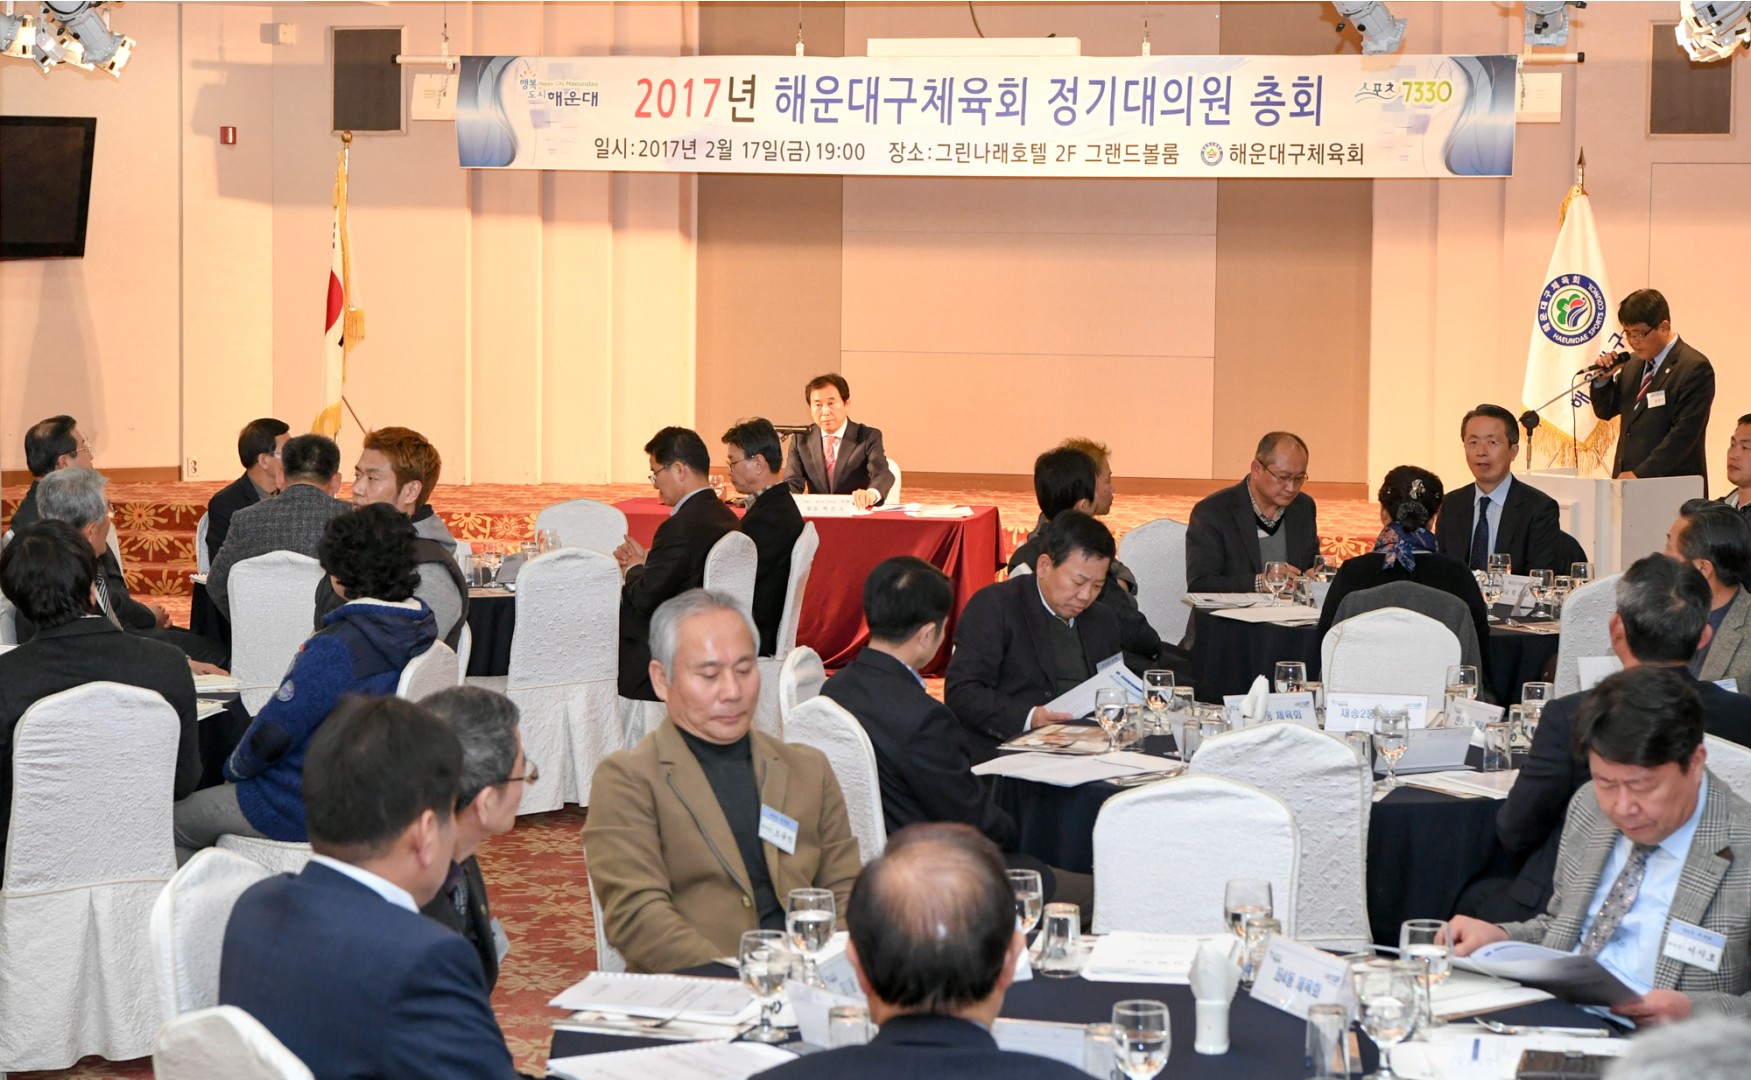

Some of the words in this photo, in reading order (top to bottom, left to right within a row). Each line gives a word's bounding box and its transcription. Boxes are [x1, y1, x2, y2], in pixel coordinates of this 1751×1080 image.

[519, 79, 537, 90] 행복
[1357, 82, 1396, 96] 스포츠
[1402, 81, 1453, 103] 7330
[527, 89, 546, 99] 도시
[547, 91, 599, 107] 해운대
[634, 74, 756, 123] 2017년
[774, 74, 1028, 126] 해운대구체육회
[1048, 75, 1232, 127] 정기대의원
[1250, 75, 1323, 127] 총회
[705, 139, 733, 160] 2월
[1055, 144, 1077, 162] 2F
[1085, 142, 1180, 165] 그랜드볼룸
[1229, 142, 1364, 165] 해운대구체육회
[1552, 332, 1590, 345] HAEUNDAE
[1588, 311, 1605, 337] SPORTS
